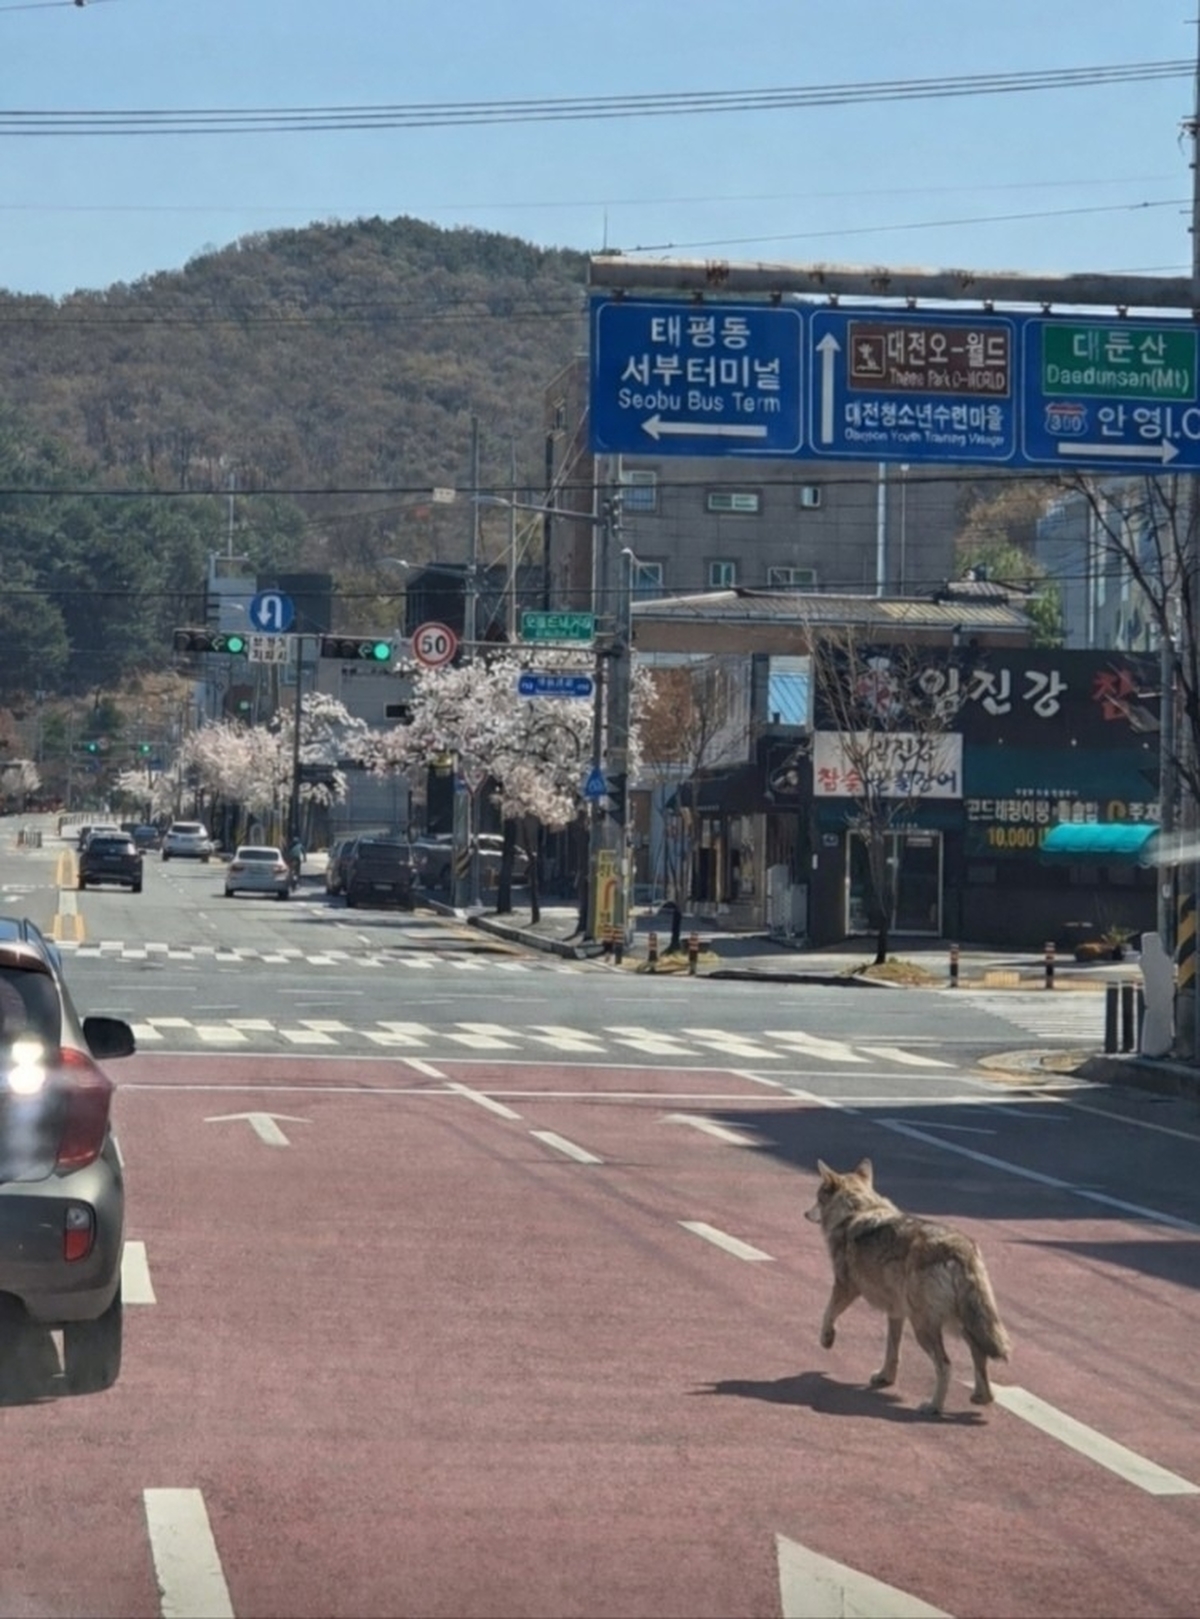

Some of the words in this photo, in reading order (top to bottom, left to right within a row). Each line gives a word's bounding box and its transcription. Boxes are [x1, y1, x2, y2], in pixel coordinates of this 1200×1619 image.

[651, 315, 751, 349] 태평동
[1073, 331, 1167, 364] 대둔산
[887, 330, 1006, 367] 대전오-월드
[621, 354, 781, 391] 서부터미널
[1047, 364, 1189, 394] Daedunsan(Mt)
[618, 389, 681, 410] Seobu
[688, 391, 724, 411] Bus
[732, 392, 781, 413] Term
[845, 402, 1003, 431] 대전청소년수련마을
[422, 636, 447, 655] 50
